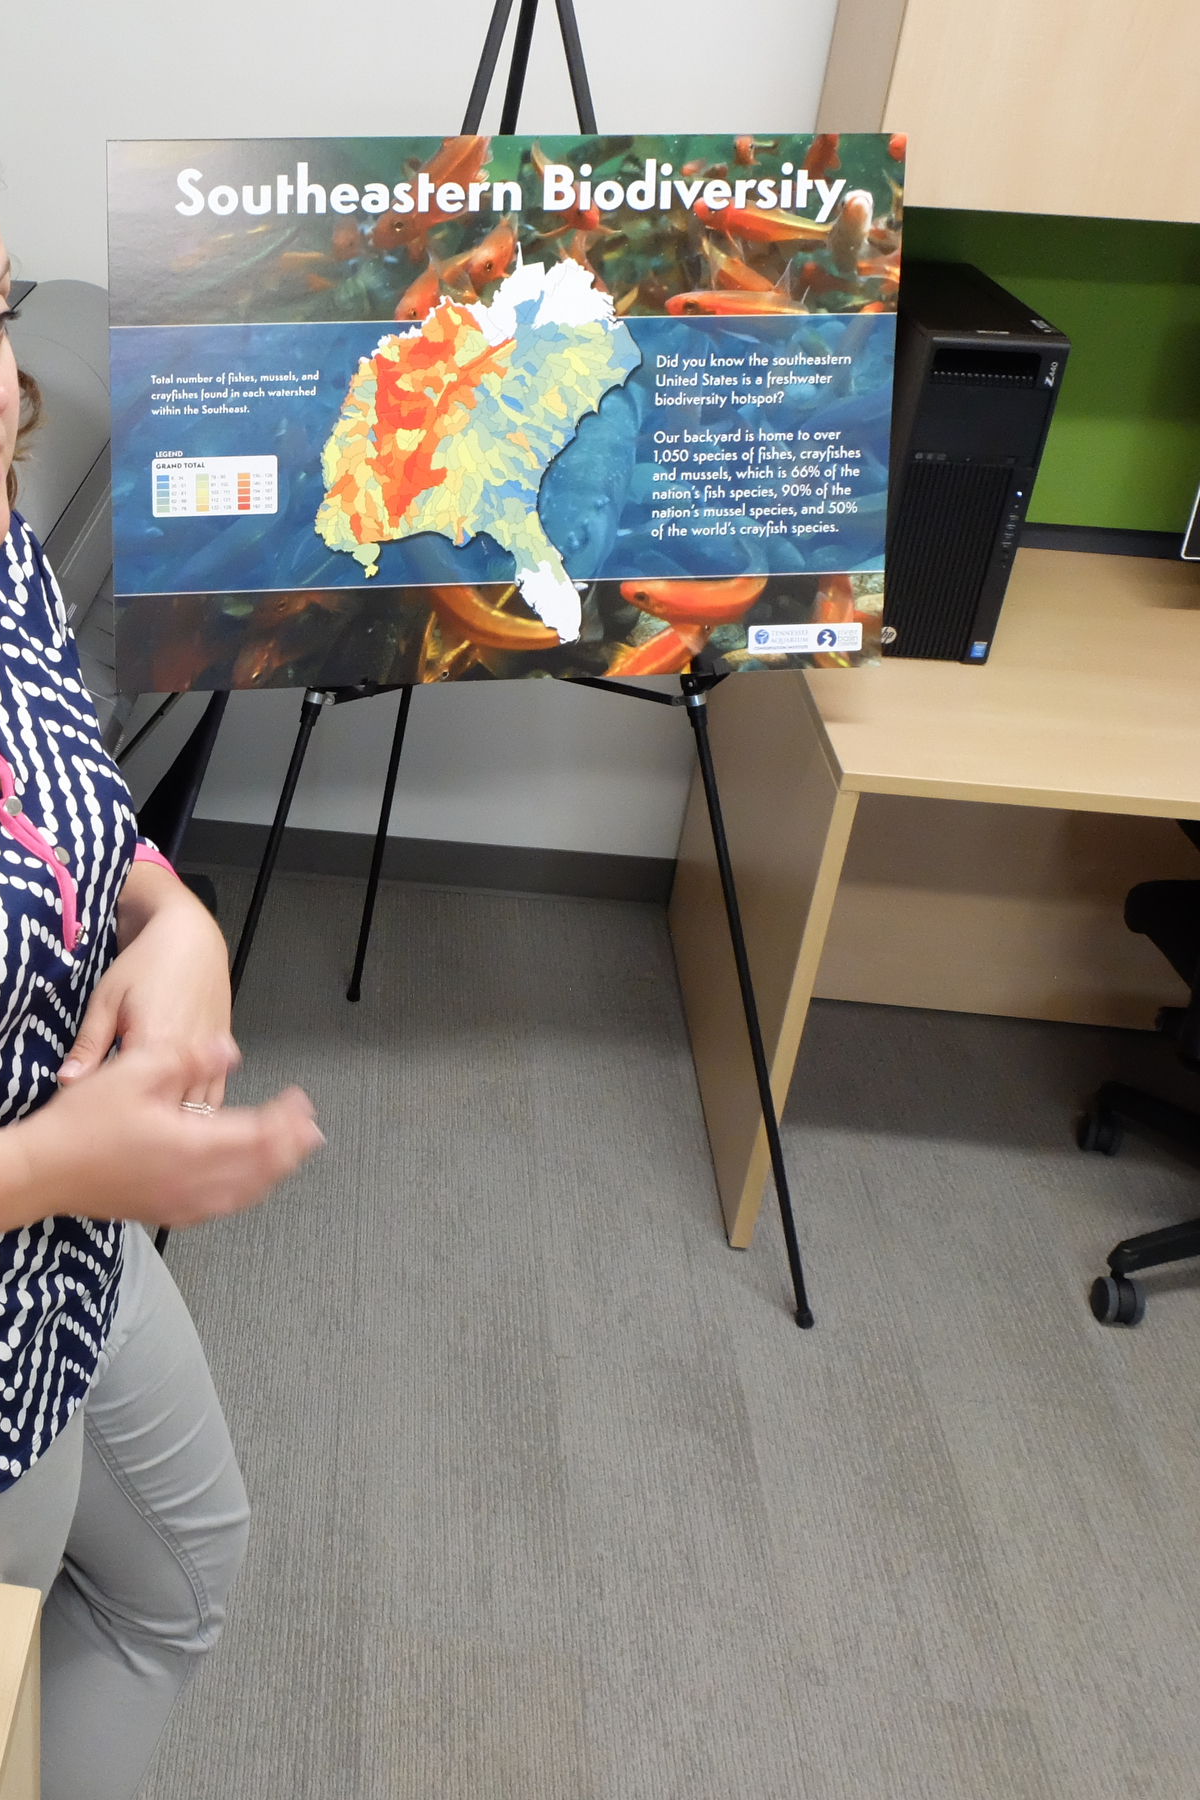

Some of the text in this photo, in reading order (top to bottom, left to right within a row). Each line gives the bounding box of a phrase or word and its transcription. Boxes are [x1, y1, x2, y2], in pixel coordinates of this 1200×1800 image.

[175, 158, 847, 223] Southeastern Biodiversity
[656, 352, 852, 371] Did you know the southeastern
[151, 370, 320, 385] Total number of fishes, mussels, and
[655, 371, 833, 388] United States is a freshwater
[151, 386, 317, 402] crayfishes found in each watershed
[654, 390, 785, 408] biodiversity hotspot?
[151, 403, 250, 416] within the Southeast.
[653, 428, 842, 446] Our backyard is home to over
[155, 450, 184, 458] LEGEND
[653, 445, 862, 465] 1,050 species of fishes, crayfishes
[652, 463, 861, 482] and mussels, which is 66% of the
[652, 482, 852, 502] nation's fish species, 90% of the
[651, 501, 858, 519] nation's mussel species, and 50%
[651, 520, 839, 540] of the world's crayfish species.
[770, 636, 809, 644] AQUARIUM
[837, 628, 859, 636] river
[881, 627, 897, 643] hp
